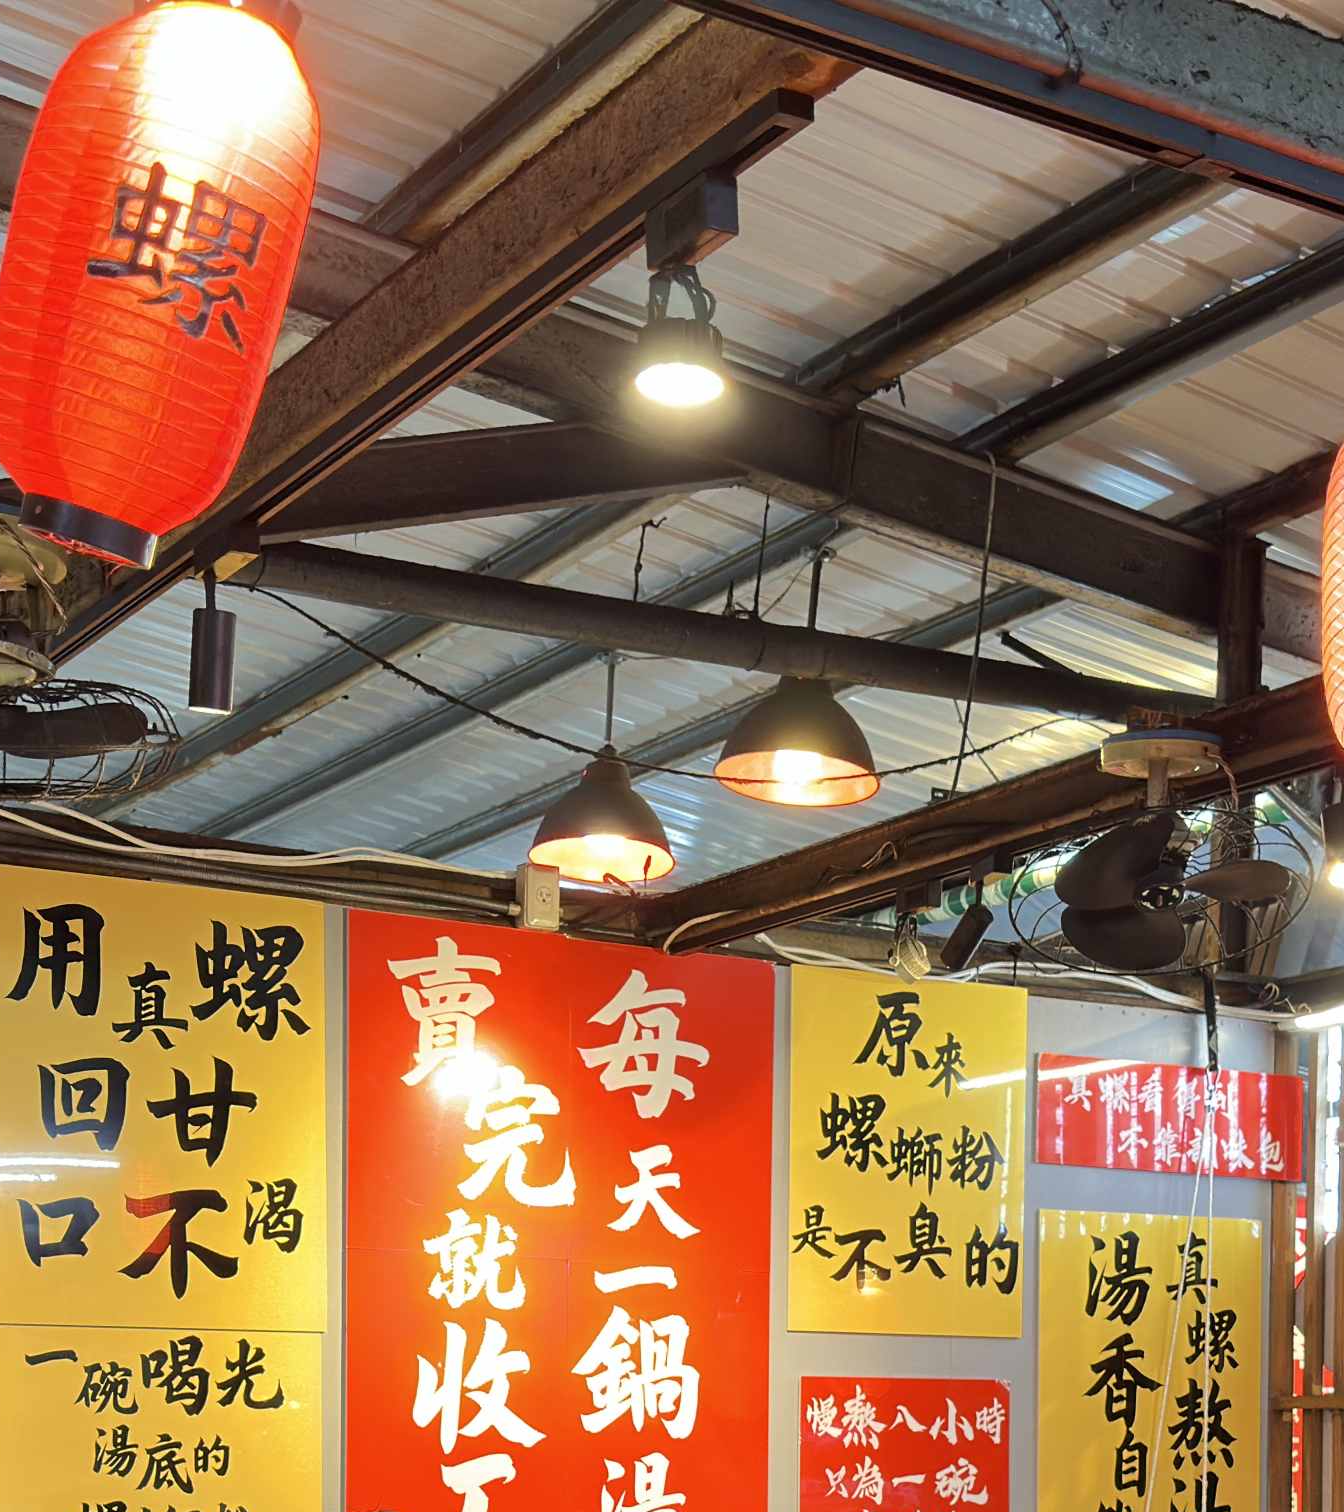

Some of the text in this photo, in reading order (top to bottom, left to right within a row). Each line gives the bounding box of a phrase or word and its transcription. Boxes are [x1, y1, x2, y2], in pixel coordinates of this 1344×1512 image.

[86, 161, 265, 354] 螺
[6, 903, 312, 1050] 用真螺
[854, 991, 969, 1097] 原來
[37, 1056, 258, 1168] 回甘
[816, 1092, 1007, 1196] 螺螄粉
[17, 1179, 304, 1299] 口不渴
[792, 1202, 1019, 1296] 是不臭的
[25, 1336, 285, 1416] 一碗喝光
[806, 1384, 1006, 1450] 慢熬八小時
[92, 1426, 232, 1495] 湯底的
[824, 1455, 989, 1506] 只為一碗
